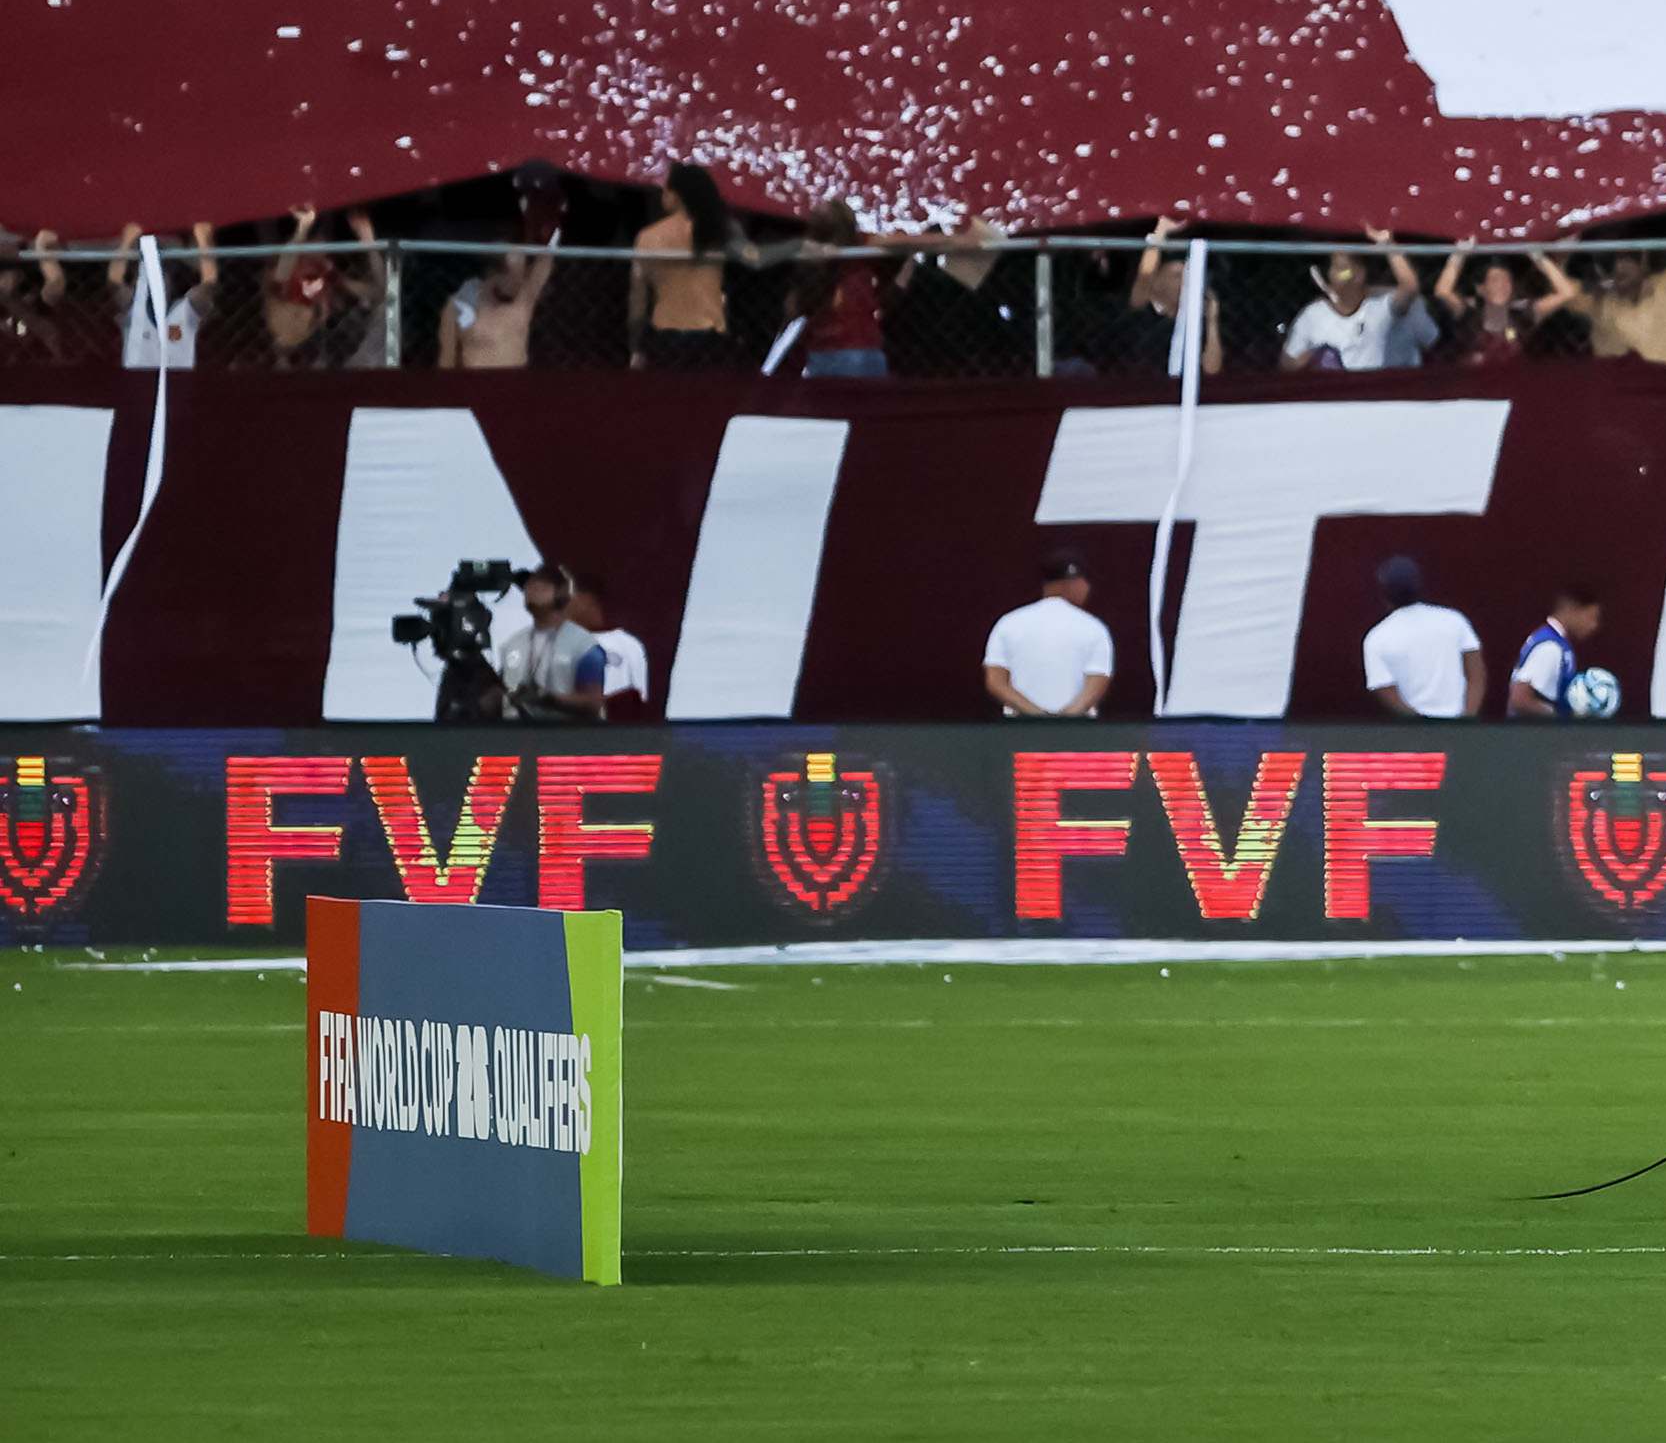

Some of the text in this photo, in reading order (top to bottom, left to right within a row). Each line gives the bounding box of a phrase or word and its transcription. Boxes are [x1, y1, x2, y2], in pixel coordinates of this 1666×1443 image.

[226, 754, 664, 925] FVF
[1012, 750, 1448, 921] FVF
[319, 1010, 357, 1126] FIFA
[357, 1015, 420, 1133] WORLD
[421, 1018, 454, 1137] CUP
[494, 1025, 592, 1156] QUALIFIERS
